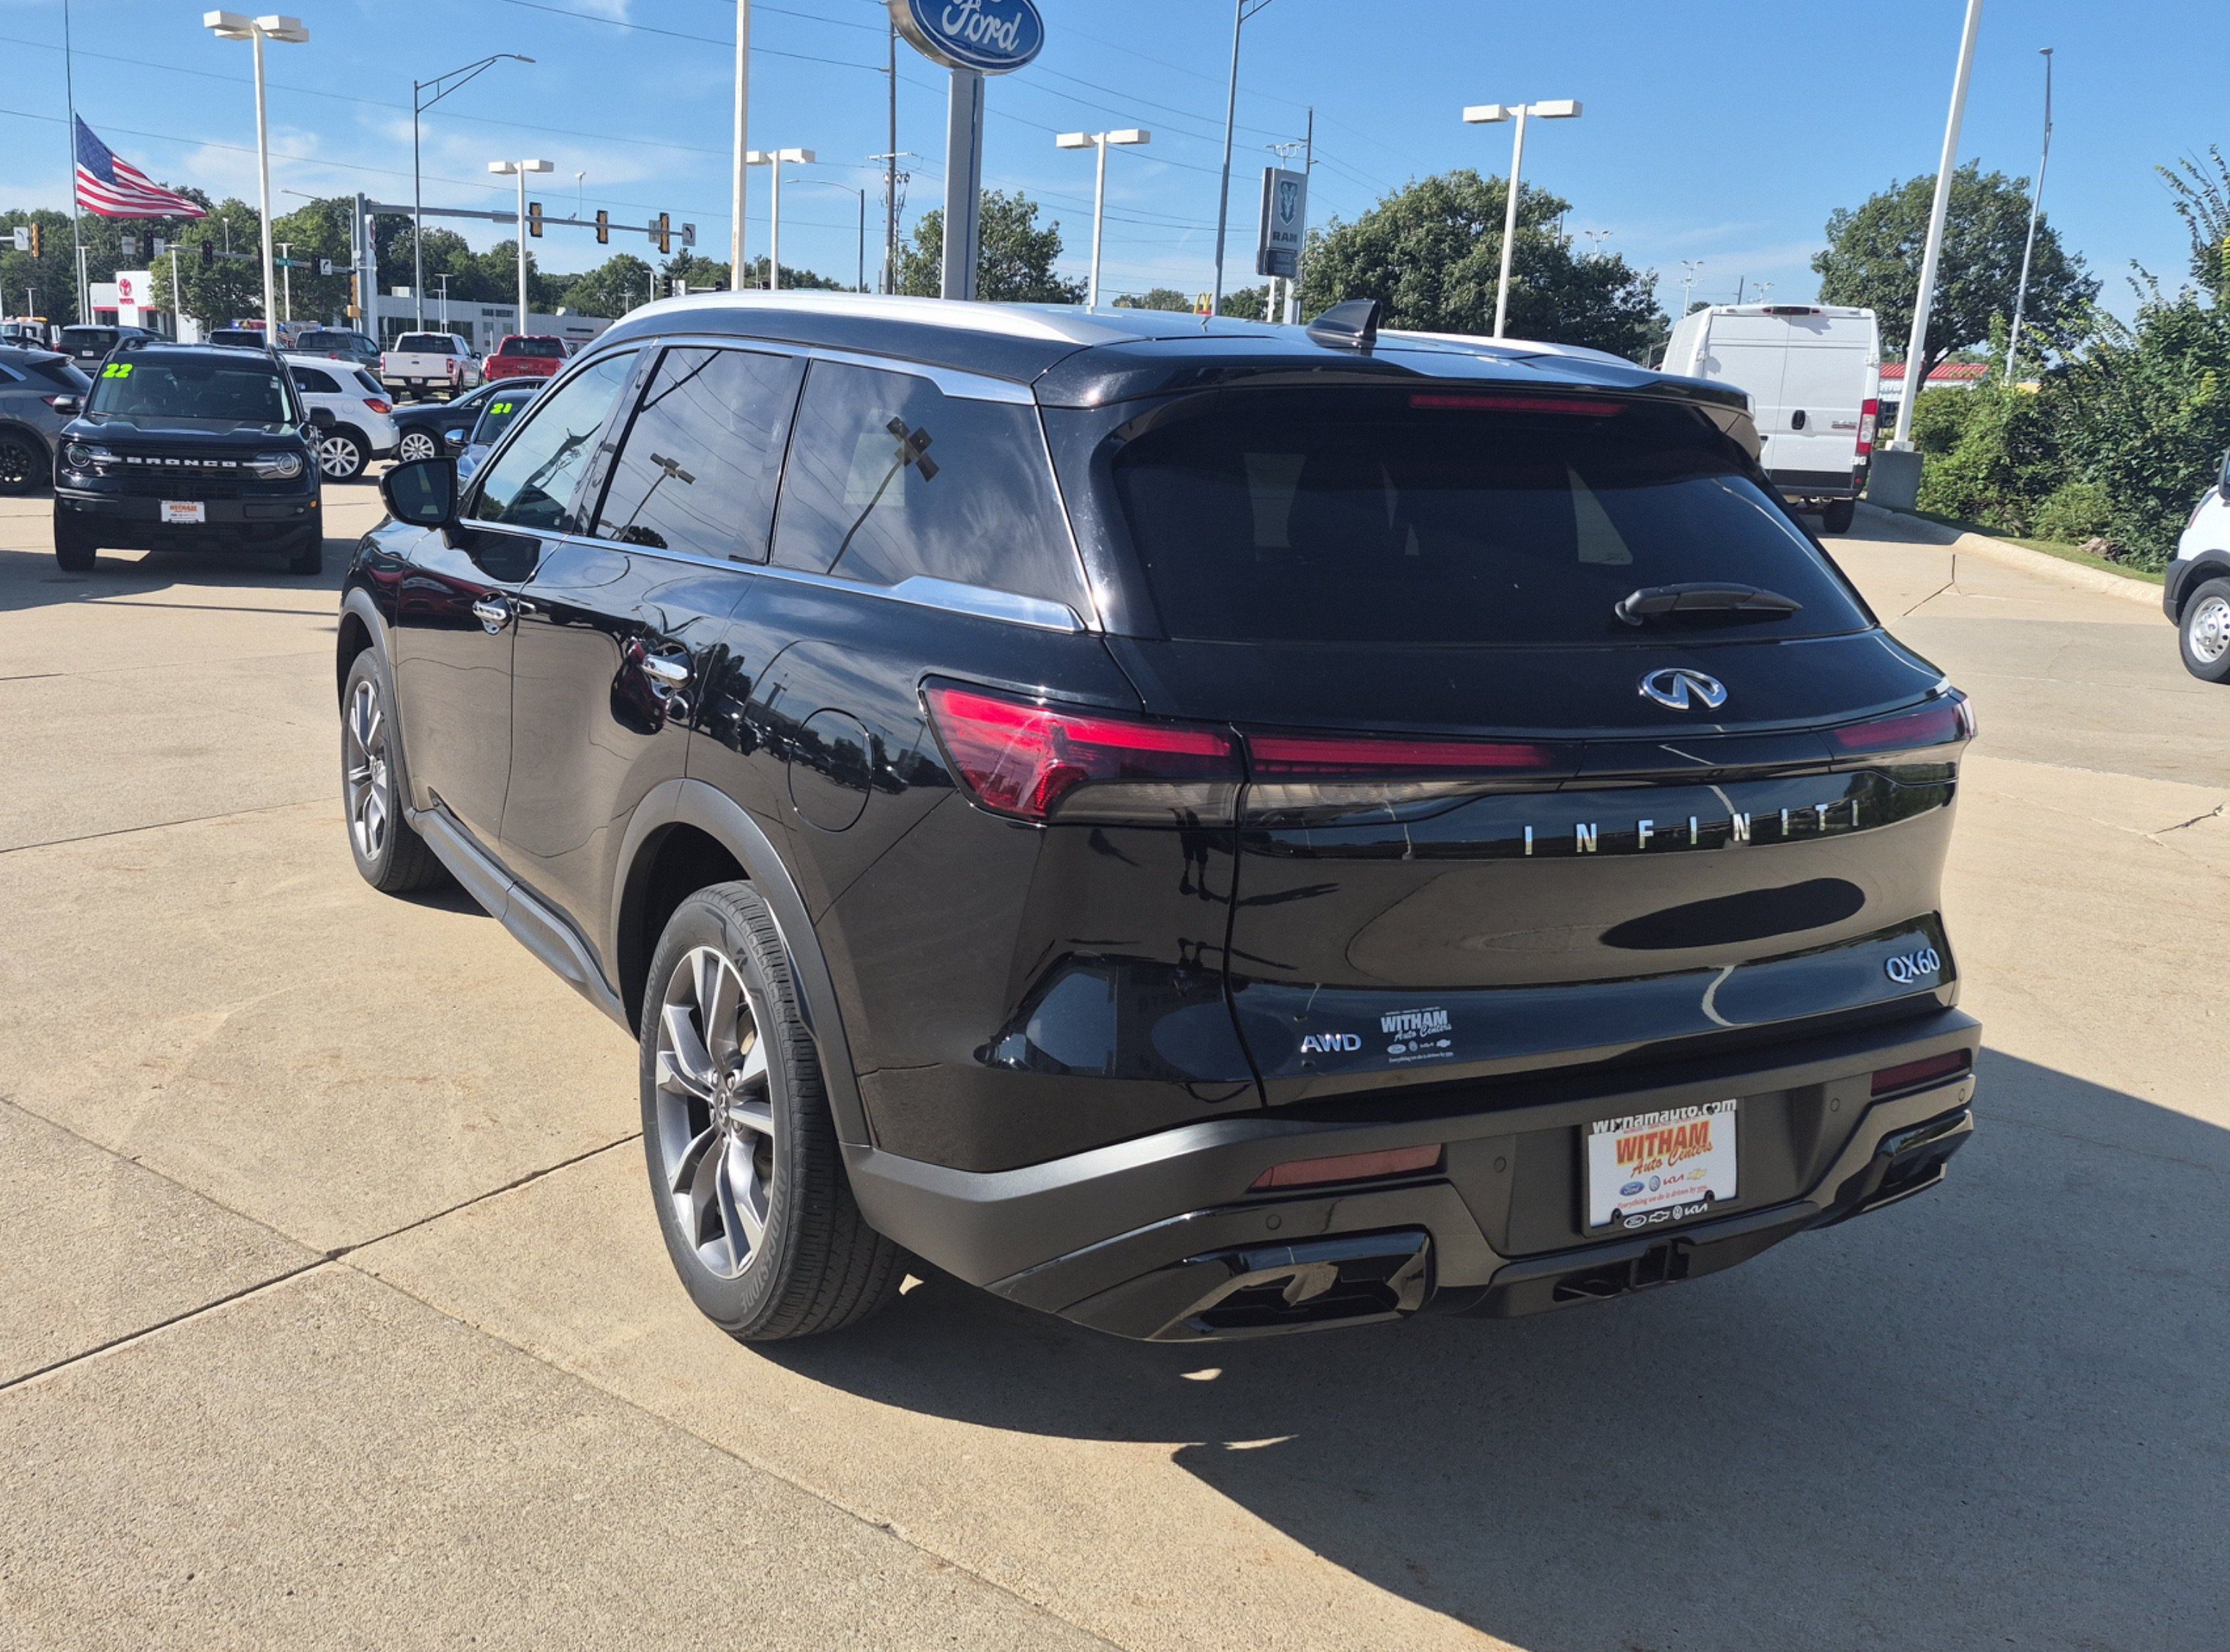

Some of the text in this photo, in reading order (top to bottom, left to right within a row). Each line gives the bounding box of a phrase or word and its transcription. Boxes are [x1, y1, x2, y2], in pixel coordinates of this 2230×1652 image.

[942, 0, 1023, 51] Ford
[1272, 231, 1297, 243] RAM
[102, 363, 133, 379] 22
[489, 402, 513, 415] 21
[126, 456, 237, 468] BRONCO
[1525, 799, 1859, 856] INFINITI
[1885, 947, 1941, 984] QX60
[1380, 1010, 1448, 1034] WITHAM
[1393, 1023, 1452, 1042] Auto Centers
[1300, 1033, 1362, 1053] AWD
[1615, 1119, 1711, 1166] WITHAM
[1630, 1140, 1714, 1179] Auto Centers
